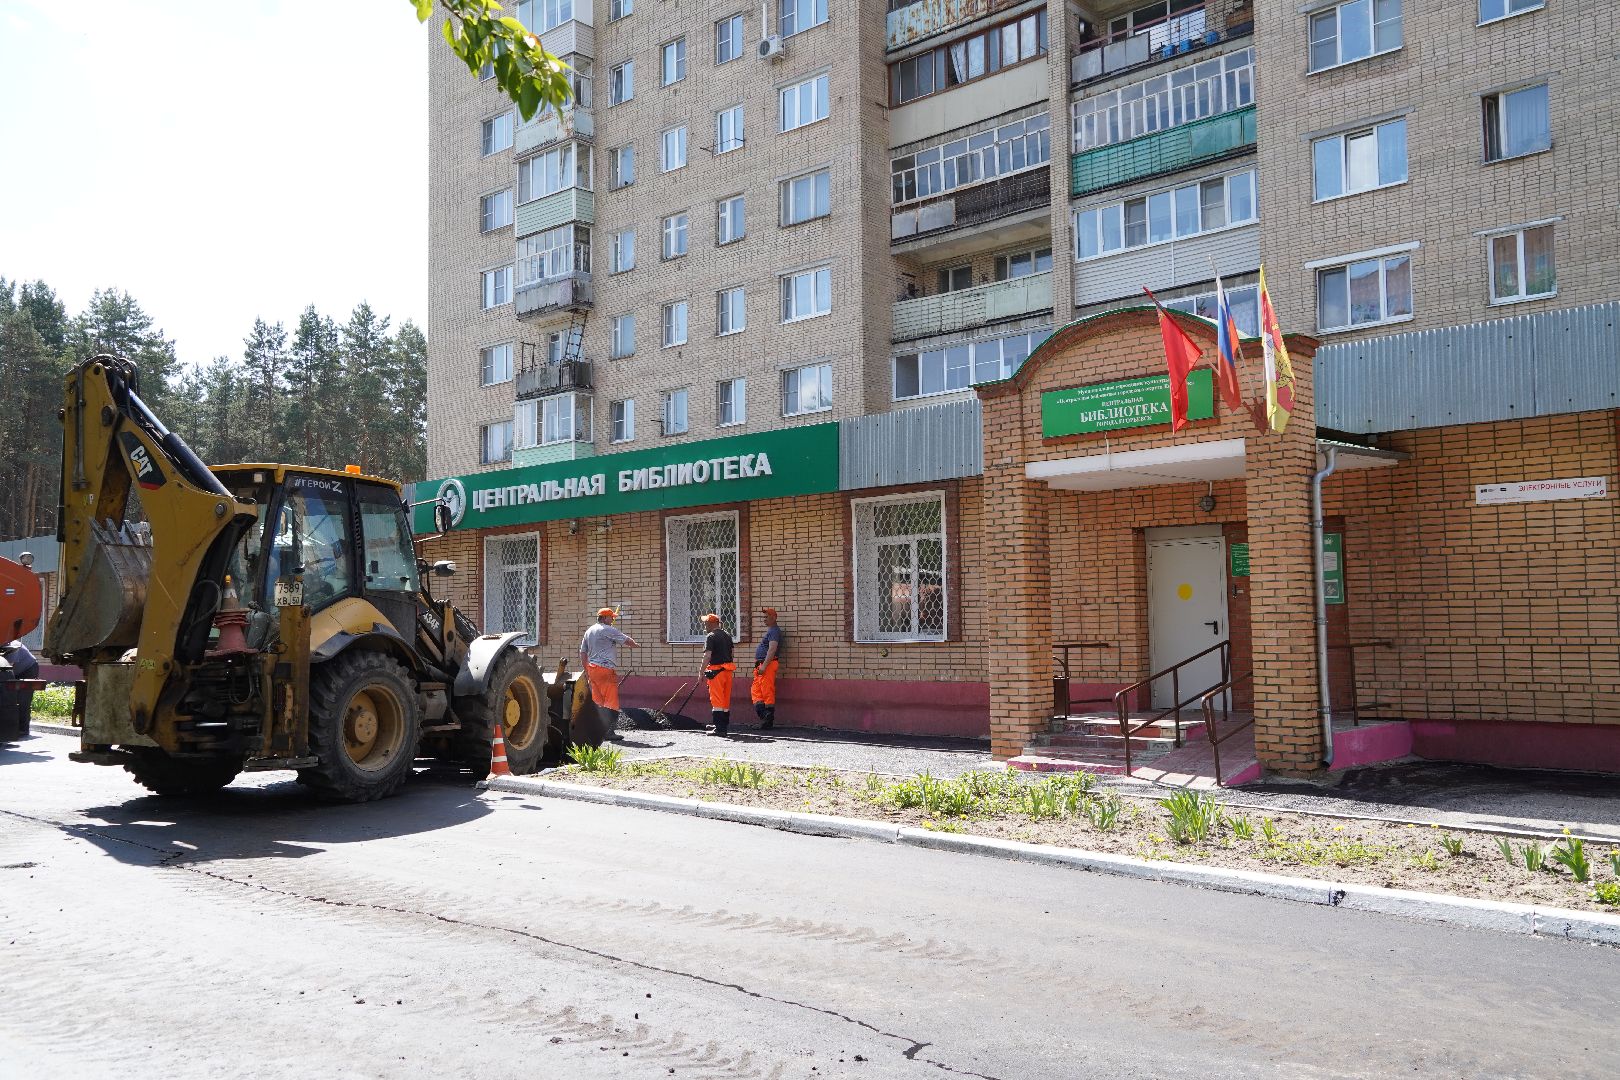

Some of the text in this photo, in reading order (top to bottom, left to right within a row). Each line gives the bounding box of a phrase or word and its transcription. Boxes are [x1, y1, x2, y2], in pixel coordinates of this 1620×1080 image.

[1101, 396, 1144, 407] ЦЕНТРАЛЬНАЯ
[1080, 401, 1169, 423] БИБЛИОТЕКА
[130, 445, 153, 478] CAT
[472, 452, 772, 513] ЦЕНТРАЛЬНАЯ БИБЛИОТЕКА
[1518, 482, 1572, 492] ЭЛЕКТРОННЫЕ
[1572, 480, 1602, 489] УСЛУГИ
[278, 583, 300, 594] 7589
